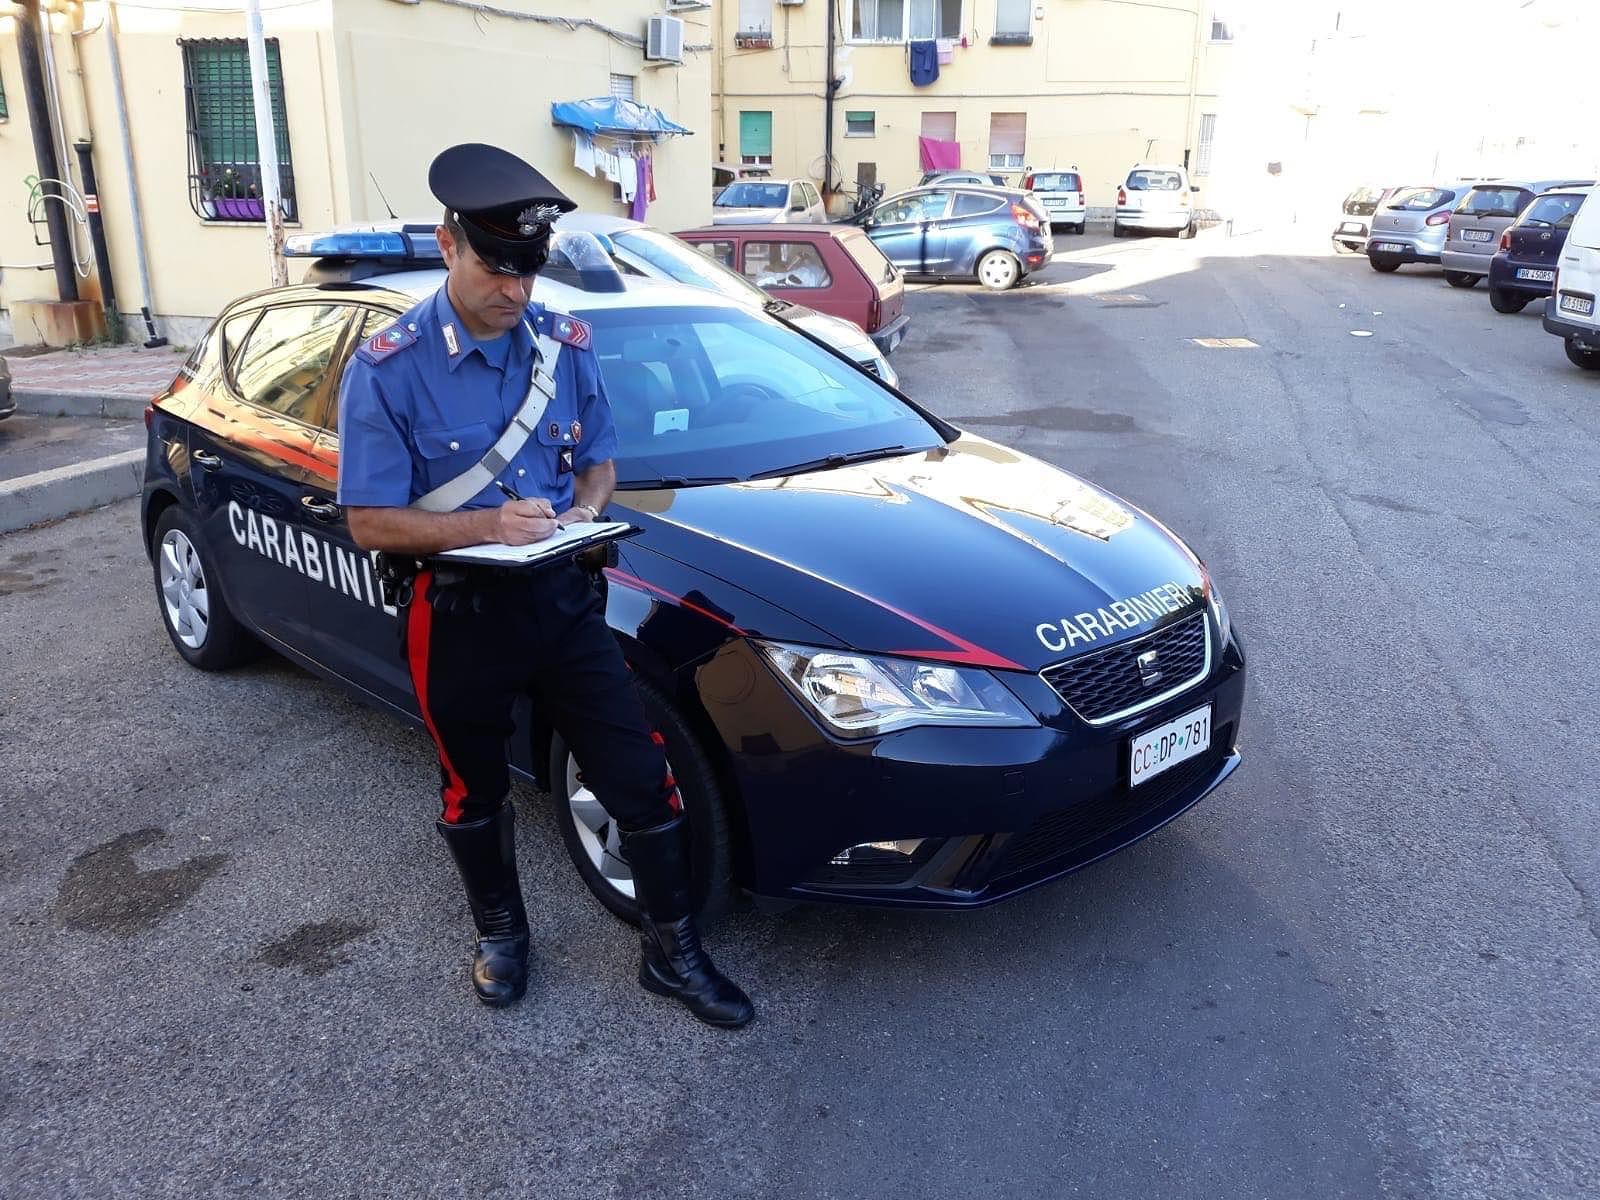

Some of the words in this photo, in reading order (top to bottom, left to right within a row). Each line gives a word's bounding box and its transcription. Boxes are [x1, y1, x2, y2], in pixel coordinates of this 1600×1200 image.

[1035, 580, 1194, 652] CARABINIERI
[1133, 743, 1152, 775] CC
[1160, 731, 1177, 762] DP
[1184, 716, 1207, 751] 781
